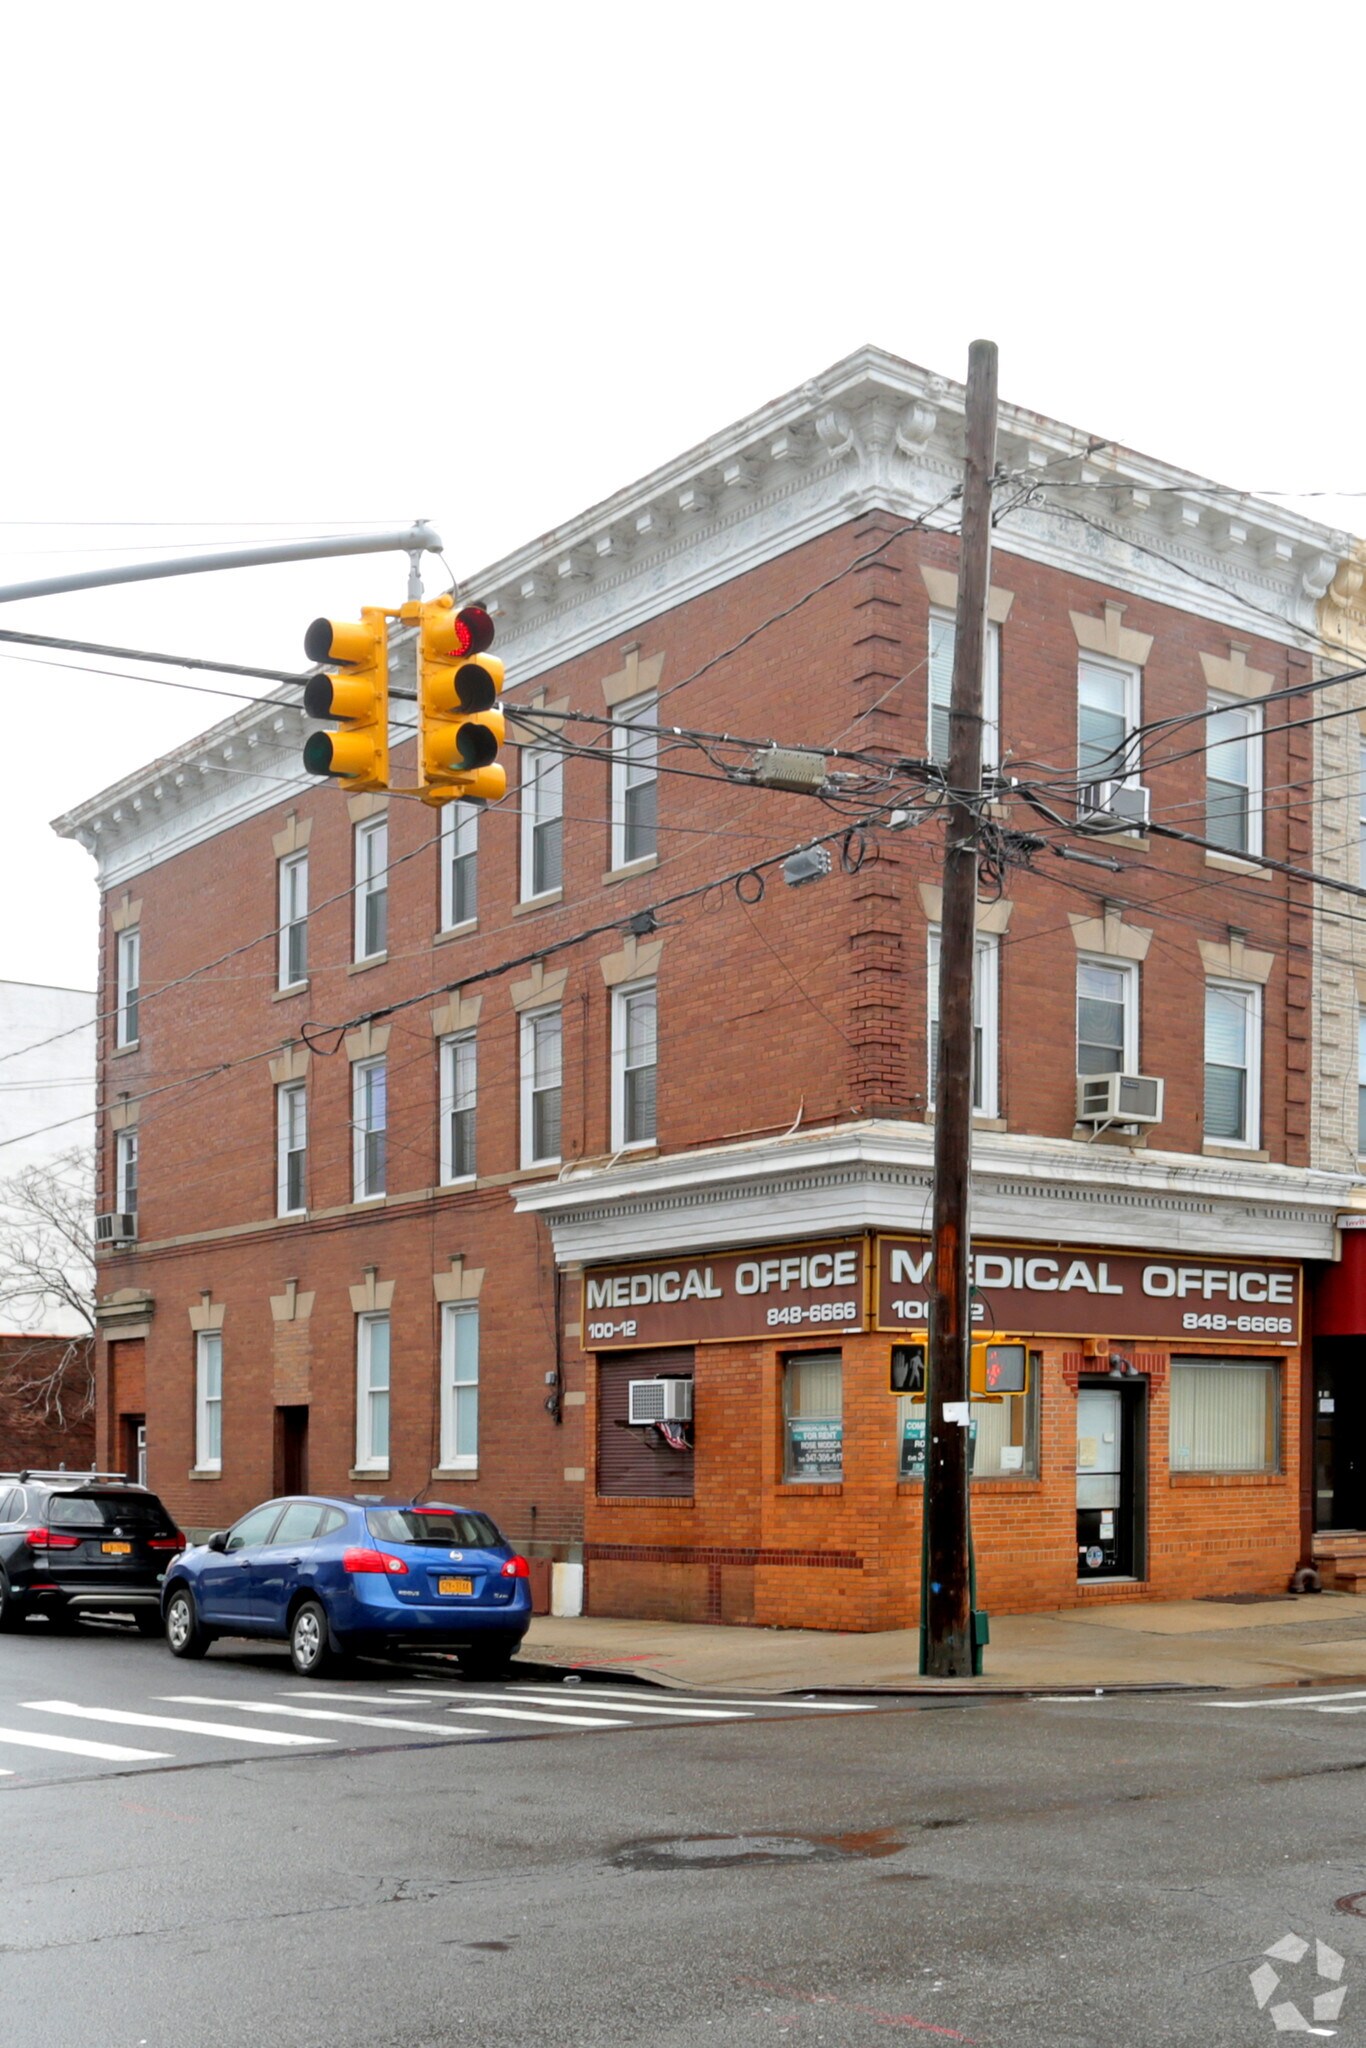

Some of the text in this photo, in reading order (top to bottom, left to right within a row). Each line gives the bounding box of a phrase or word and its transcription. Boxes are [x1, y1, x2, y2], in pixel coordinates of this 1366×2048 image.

[587, 1251, 857, 1310] MEDICAL OFFICE
[1142, 1265, 1293, 1304] OFFICE
[767, 1301, 857, 1326] 848-6666
[1182, 1313, 1292, 1333] 848-6666
[587, 1320, 637, 1339] 100-12
[803, 1432, 817, 1440] FOR
[818, 1432, 837, 1440] RENT
